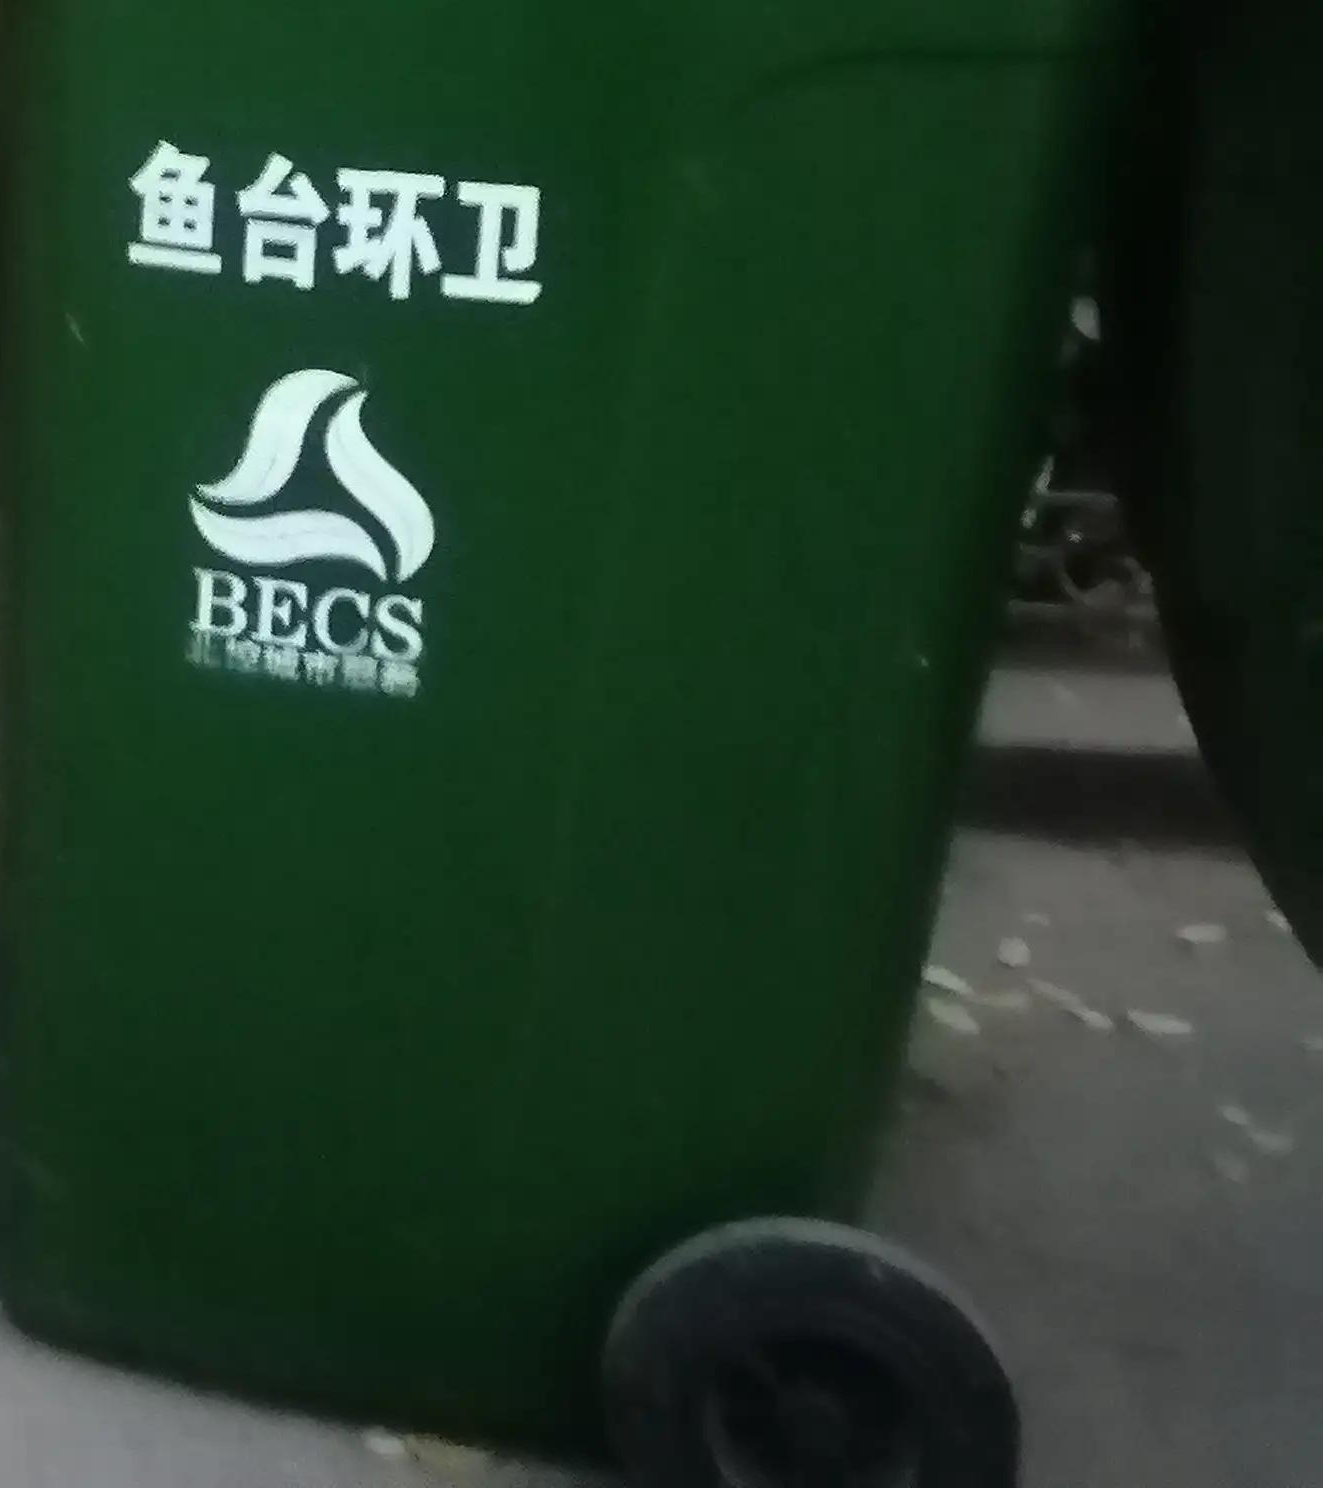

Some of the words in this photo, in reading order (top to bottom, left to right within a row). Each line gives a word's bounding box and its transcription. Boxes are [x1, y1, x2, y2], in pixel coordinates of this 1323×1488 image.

[126, 139, 543, 305] 鱼台环卫
[188, 566, 424, 664] BECS
